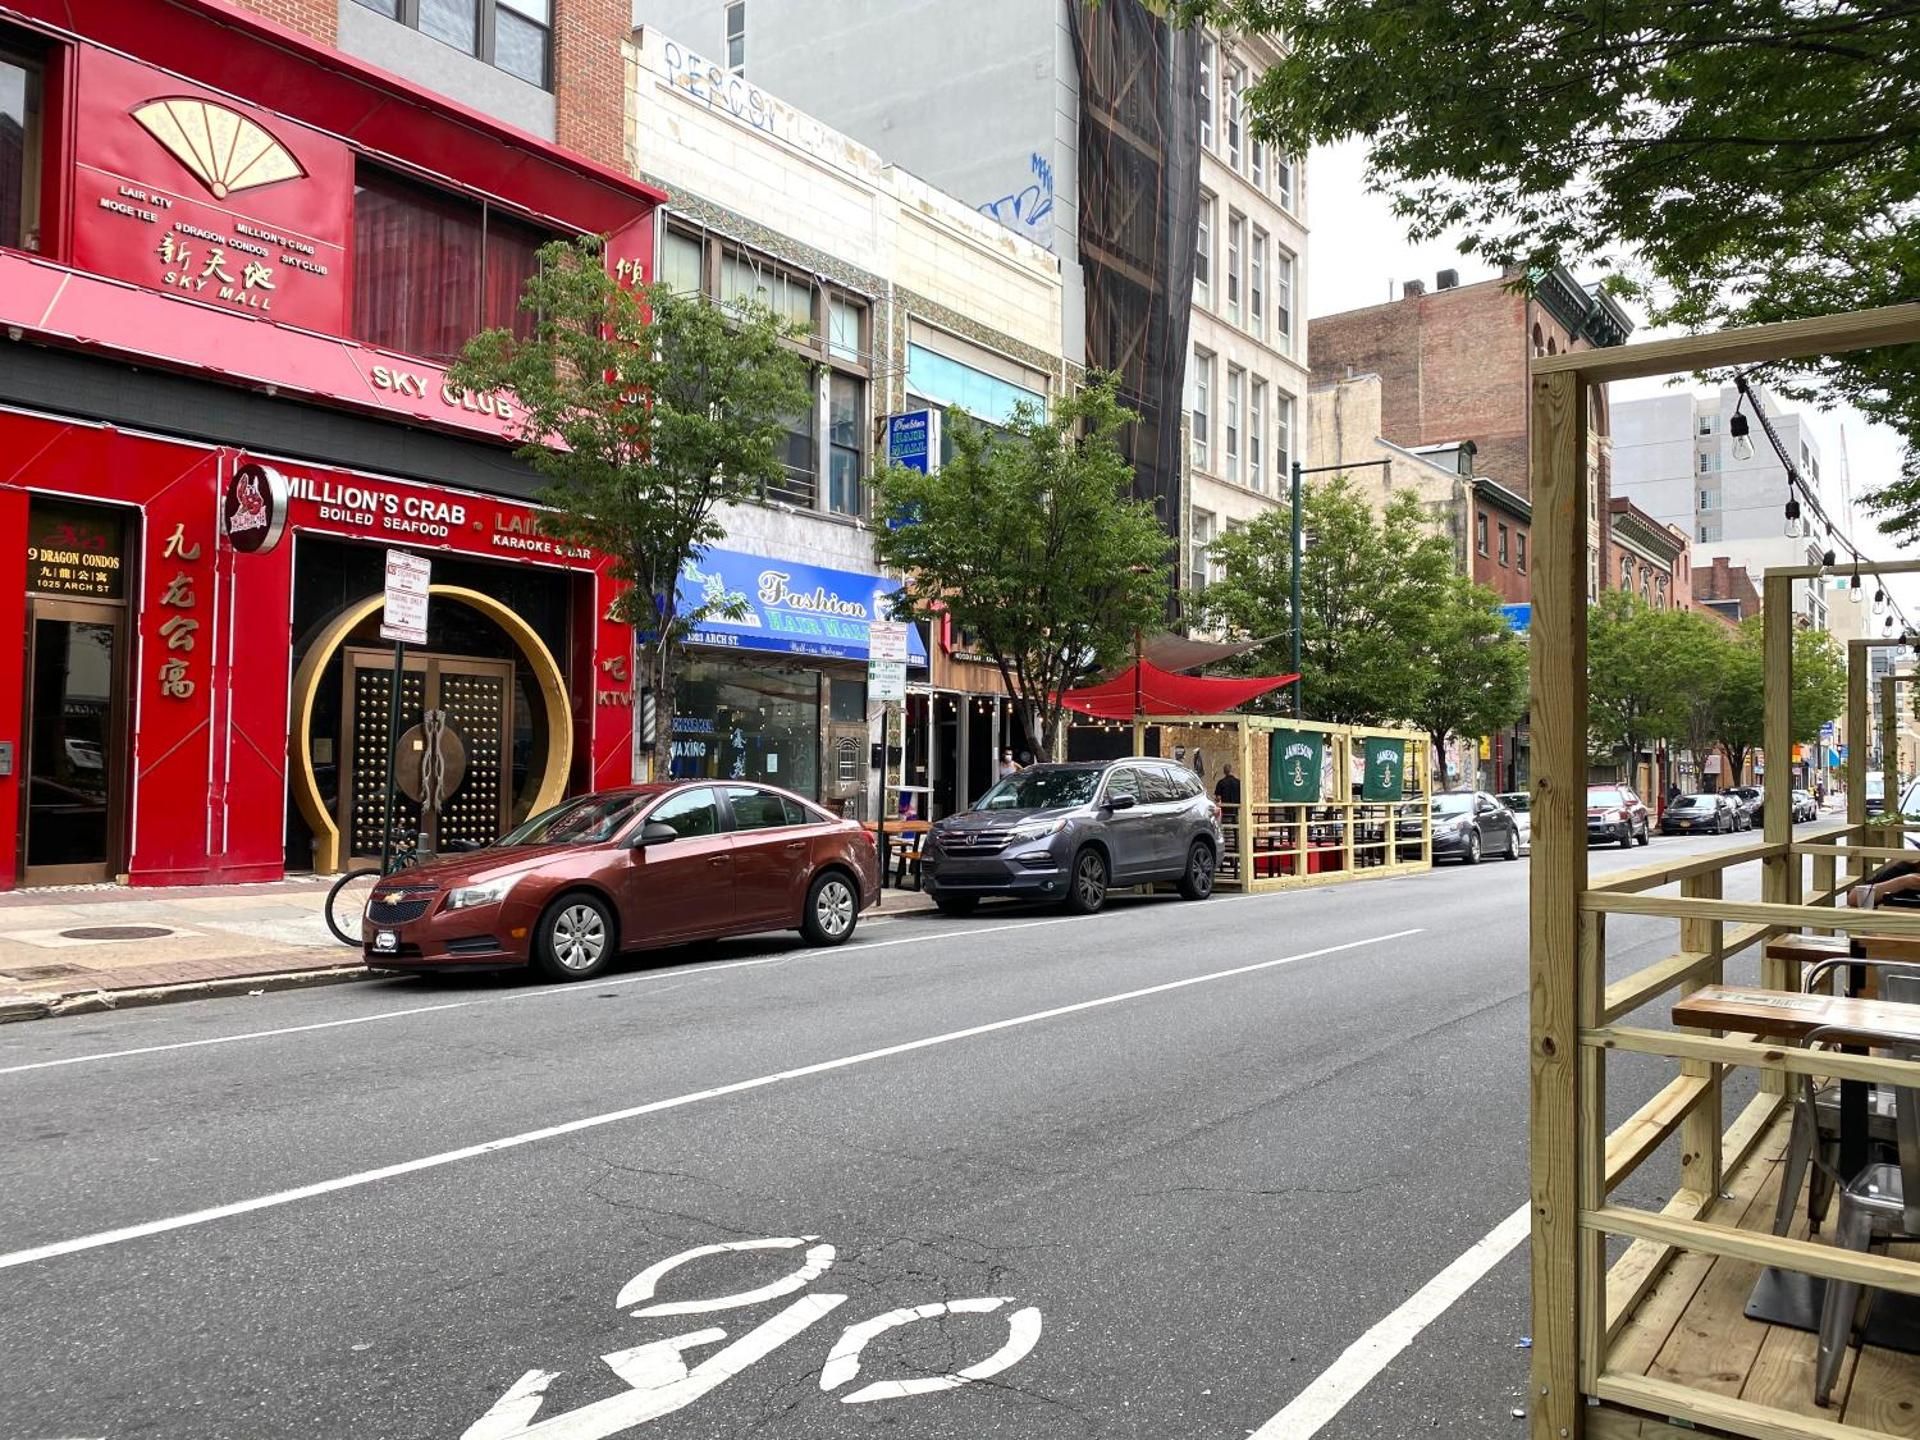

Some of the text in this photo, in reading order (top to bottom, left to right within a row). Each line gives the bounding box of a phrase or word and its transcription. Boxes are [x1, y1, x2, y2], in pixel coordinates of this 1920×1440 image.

[100, 198, 158, 222] MOGE TEE
[119, 186, 172, 209] LAIR KTV
[174, 222, 269, 257] 9 DRAGON CONDOS
[236, 223, 315, 255] MILLION'S CRAB
[157, 232, 276, 289] 新天地
[281, 254, 328, 275] SKY CLUB
[164, 272, 272, 310] SKY MALL
[371, 365, 513, 420] SKY CLUB
[285, 476, 466, 525] MILLION'S CRAB
[320, 506, 449, 537] BOILED SEAFOOD
[493, 534, 551, 553] KARAOKE
[28, 548, 120, 569] 9 DRAGON CONDOS
[38, 579, 111, 593] 1025 ARCH ST
[758, 570, 867, 618] Fashion
[765, 609, 822, 636] HAIR
[705, 633, 727, 645] ARCH
[1284, 743, 1314, 761] JAMESON
